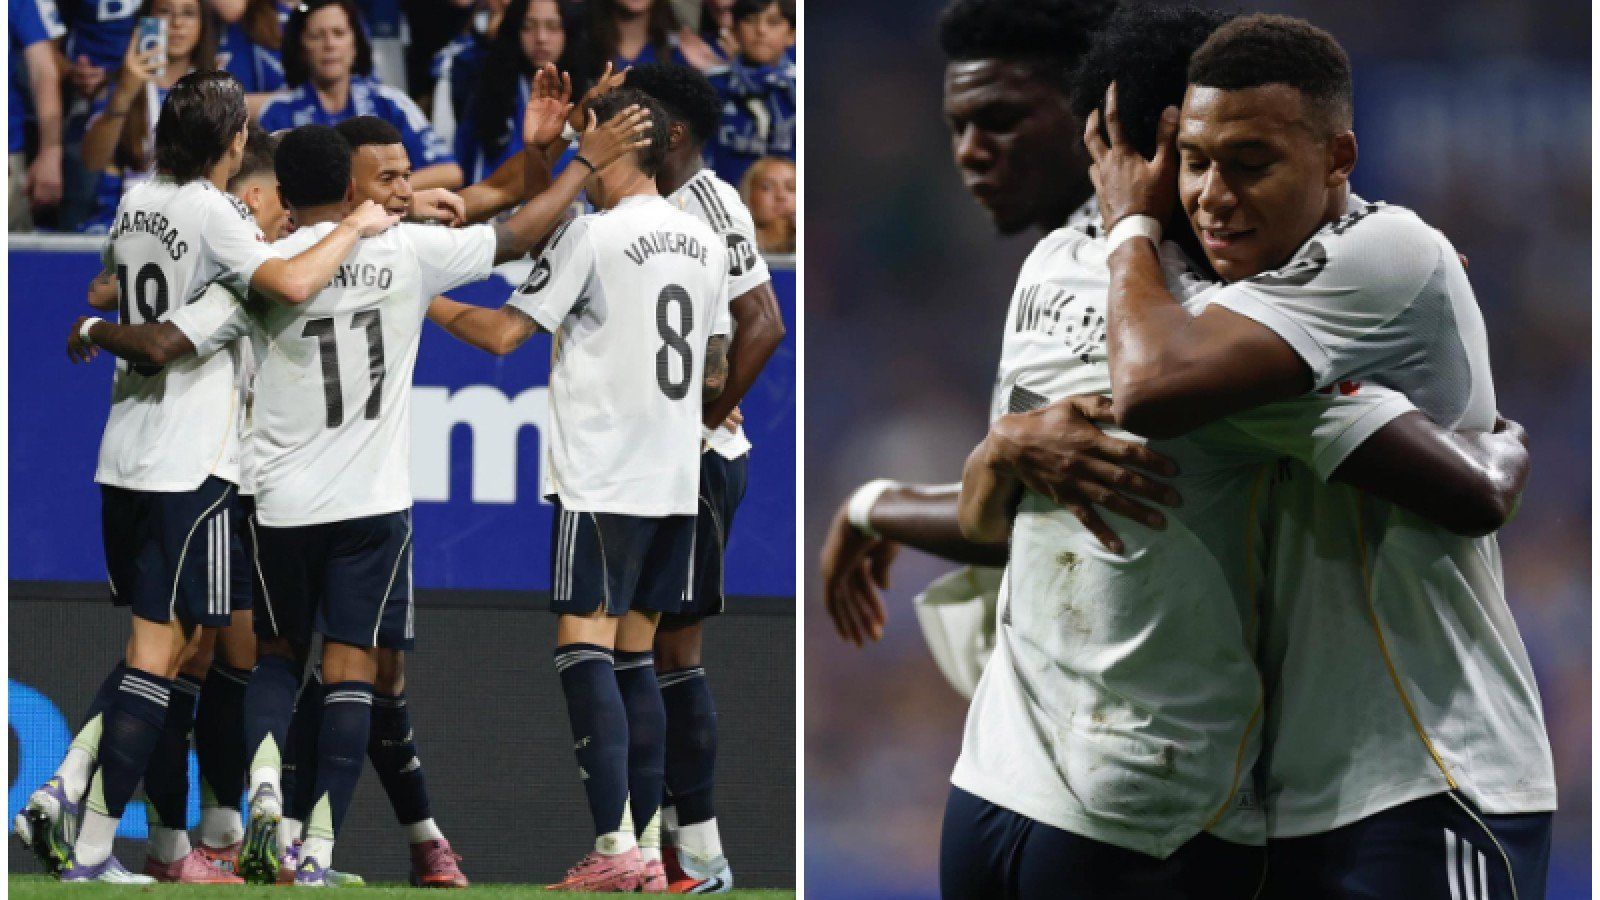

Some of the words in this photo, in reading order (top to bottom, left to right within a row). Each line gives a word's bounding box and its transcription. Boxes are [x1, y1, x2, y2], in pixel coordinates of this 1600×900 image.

[112, 210, 189, 261] ARRERAS
[624, 229, 708, 266] VALVERDE
[328, 263, 393, 290] RYGO
[656, 284, 694, 400] 8
[302, 307, 385, 429] 11
